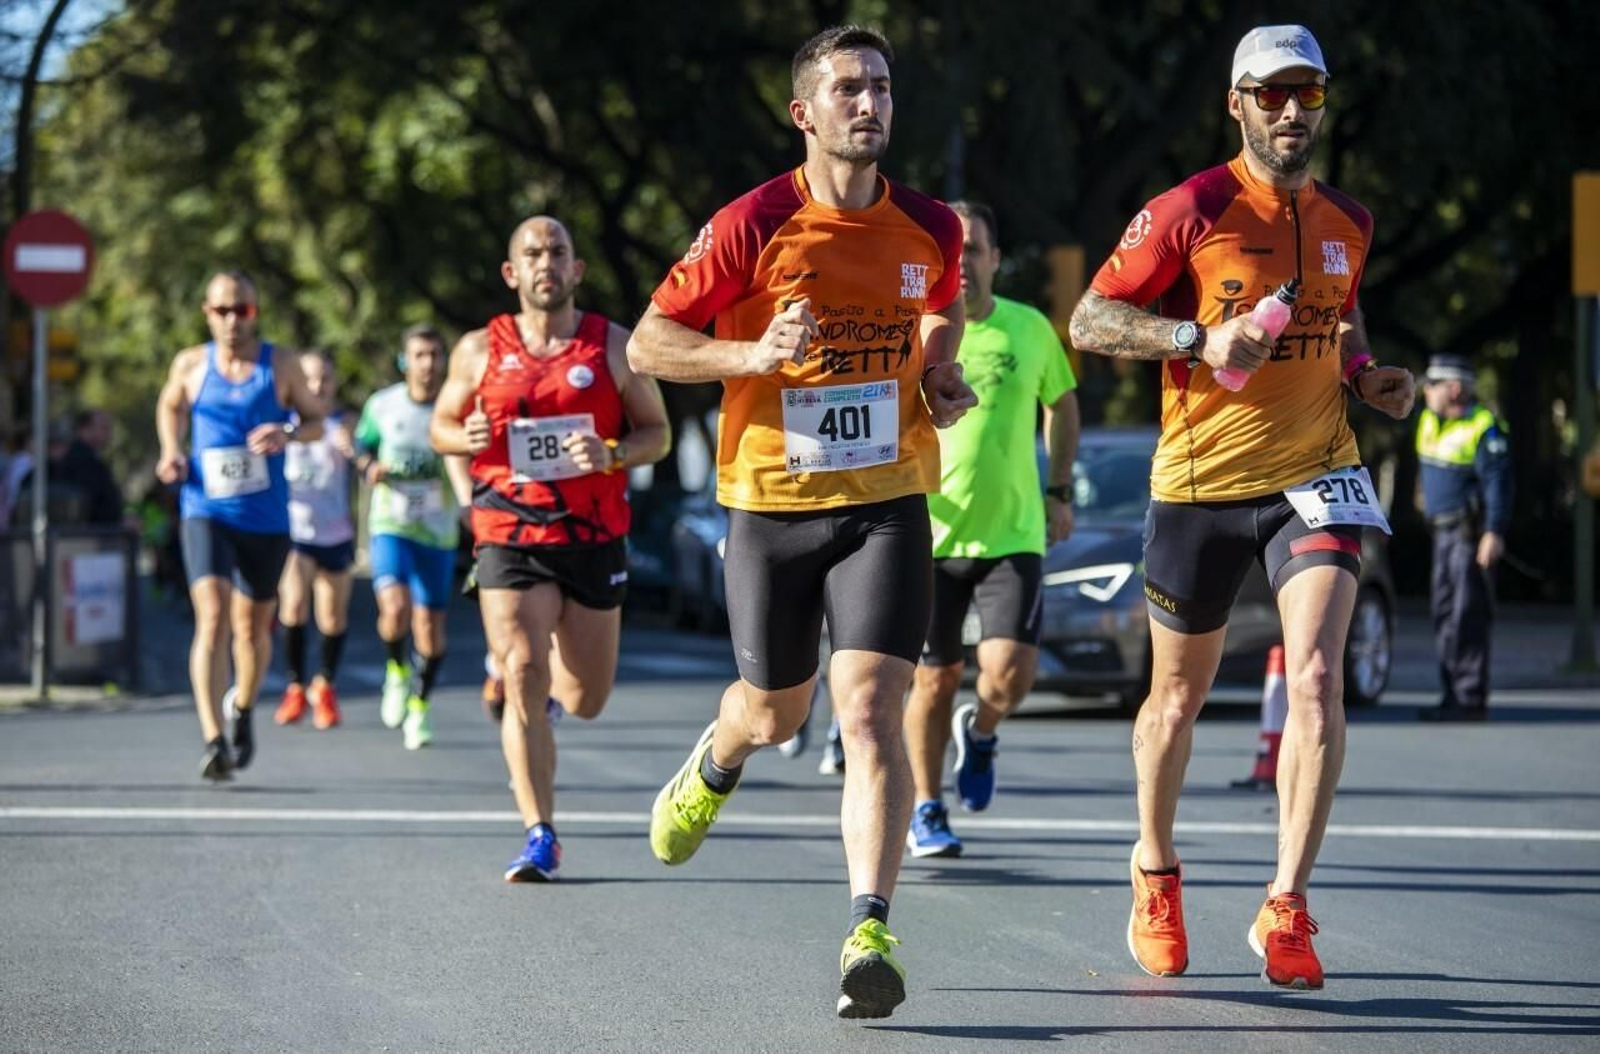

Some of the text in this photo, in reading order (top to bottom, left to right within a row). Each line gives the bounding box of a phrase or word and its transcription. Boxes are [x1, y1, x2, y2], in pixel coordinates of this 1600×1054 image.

[1275, 38, 1297, 50] edp
[1322, 241, 1346, 253] RETT
[901, 264, 929, 276] RETT
[1315, 290, 1324, 299] a
[821, 304, 864, 317] Pasito
[874, 306, 886, 317] a
[810, 320, 900, 342] NDROME
[1270, 333, 1327, 361] ETT
[820, 347, 896, 374] RETT
[818, 404, 871, 442] 401
[528, 434, 571, 461] 28
[1312, 478, 1369, 505] 278
